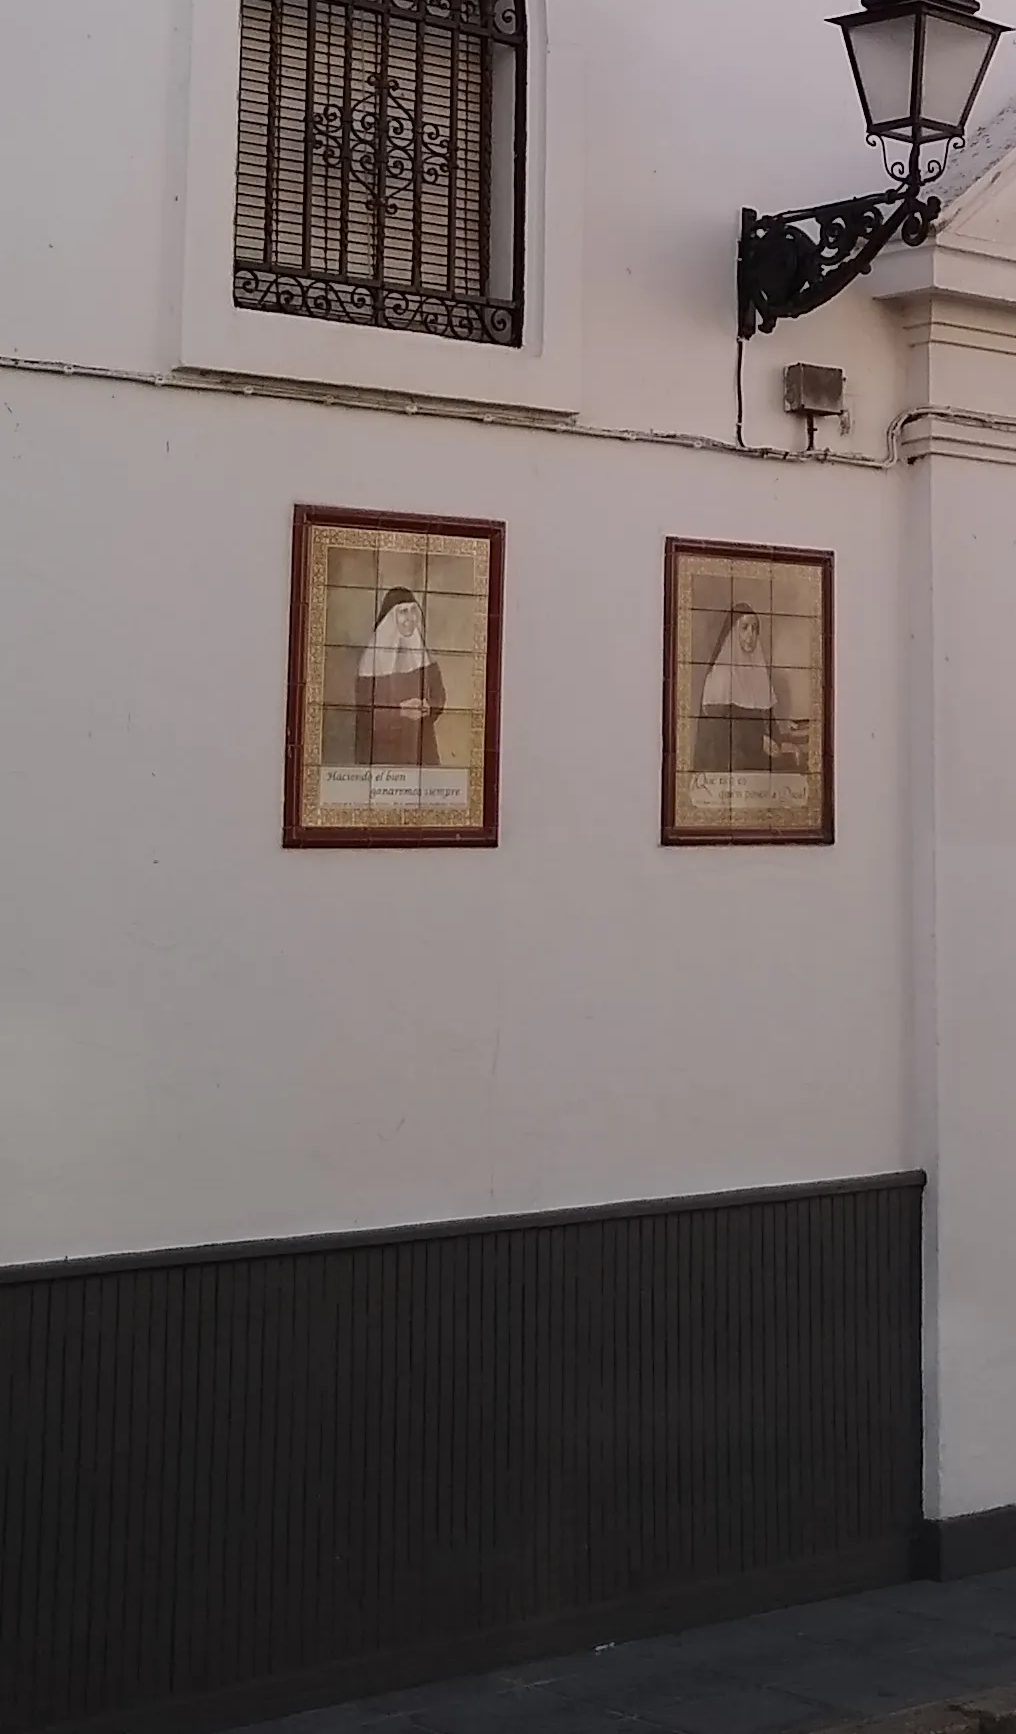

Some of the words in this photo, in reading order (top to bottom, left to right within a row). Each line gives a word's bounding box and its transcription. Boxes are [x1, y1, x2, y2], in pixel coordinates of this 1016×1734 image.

[327, 770, 373, 782] Haciendo
[375, 770, 384, 782] el
[385, 769, 407, 782] bien
[424, 787, 461, 799] siempre
